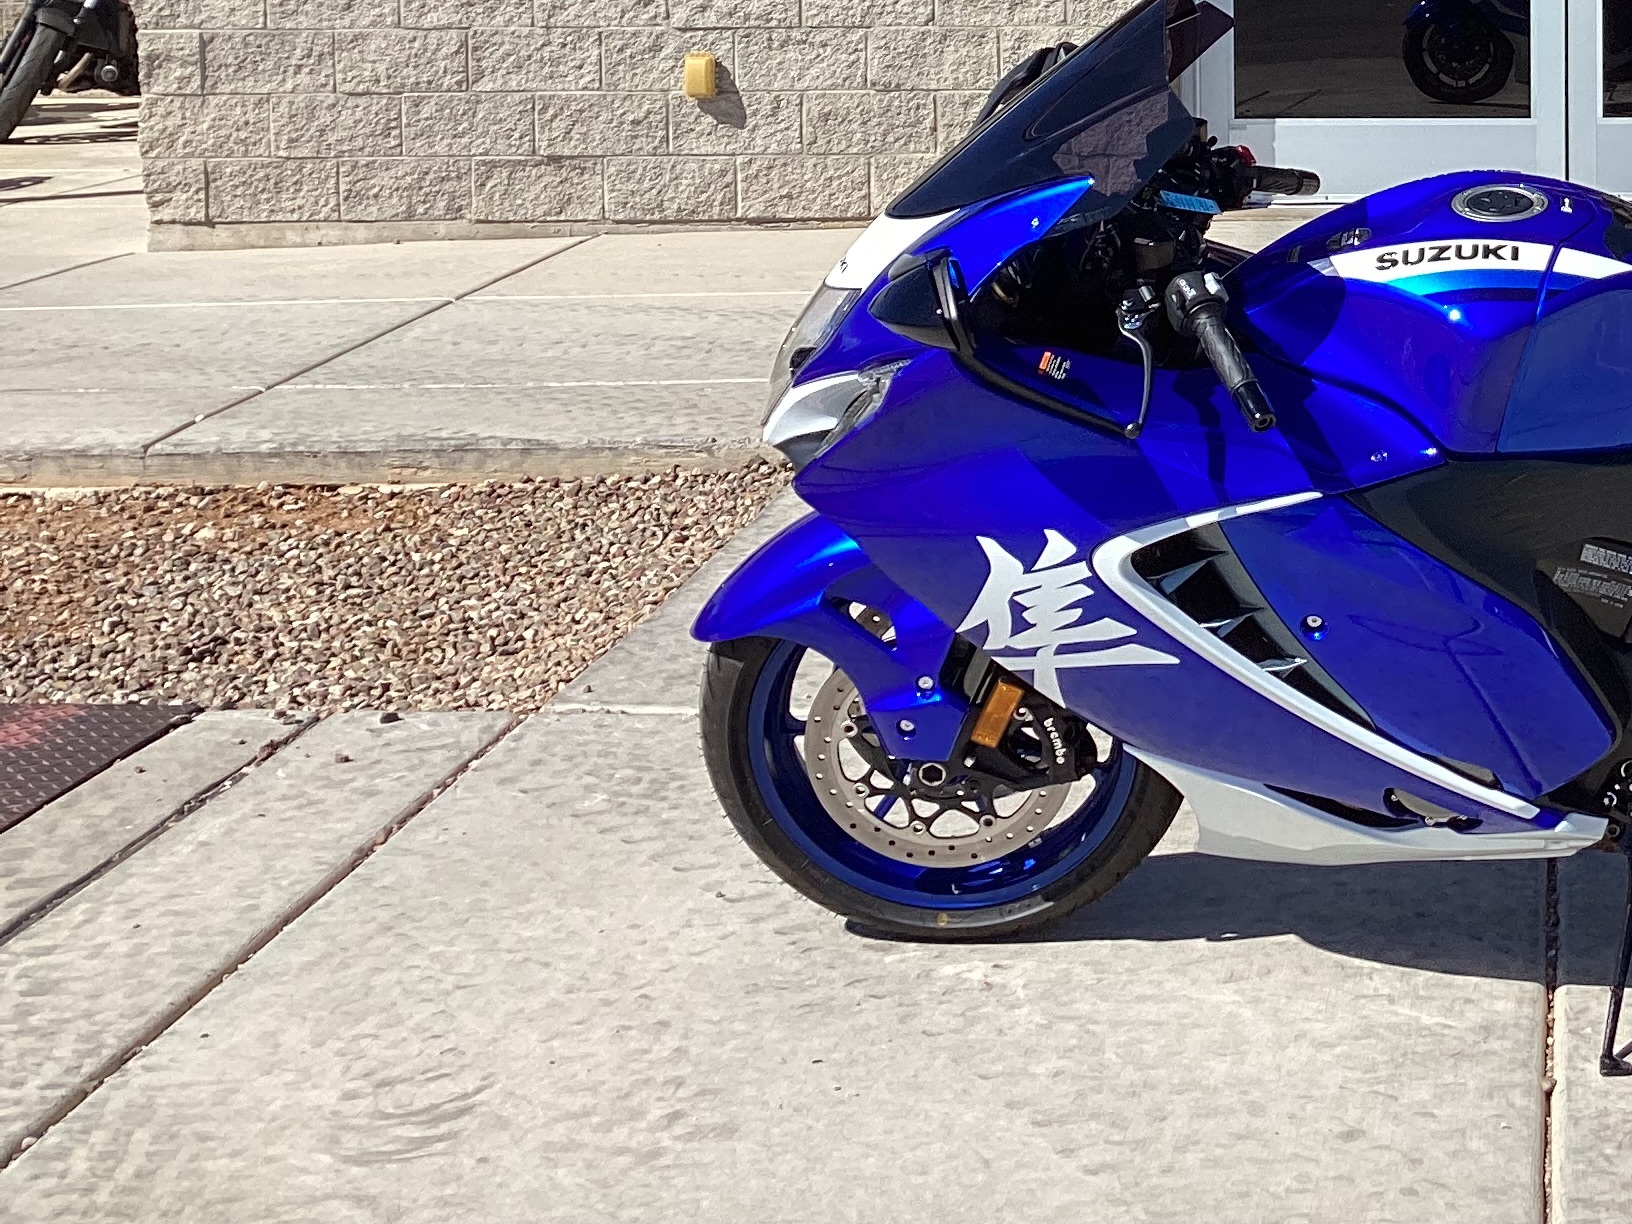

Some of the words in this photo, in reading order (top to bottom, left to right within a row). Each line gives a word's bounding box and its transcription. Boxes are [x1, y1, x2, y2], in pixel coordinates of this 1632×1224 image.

[1375, 243, 1520, 271] SUZUKI
[956, 529, 1180, 708] 隼
[1043, 717, 1067, 765] brembo
